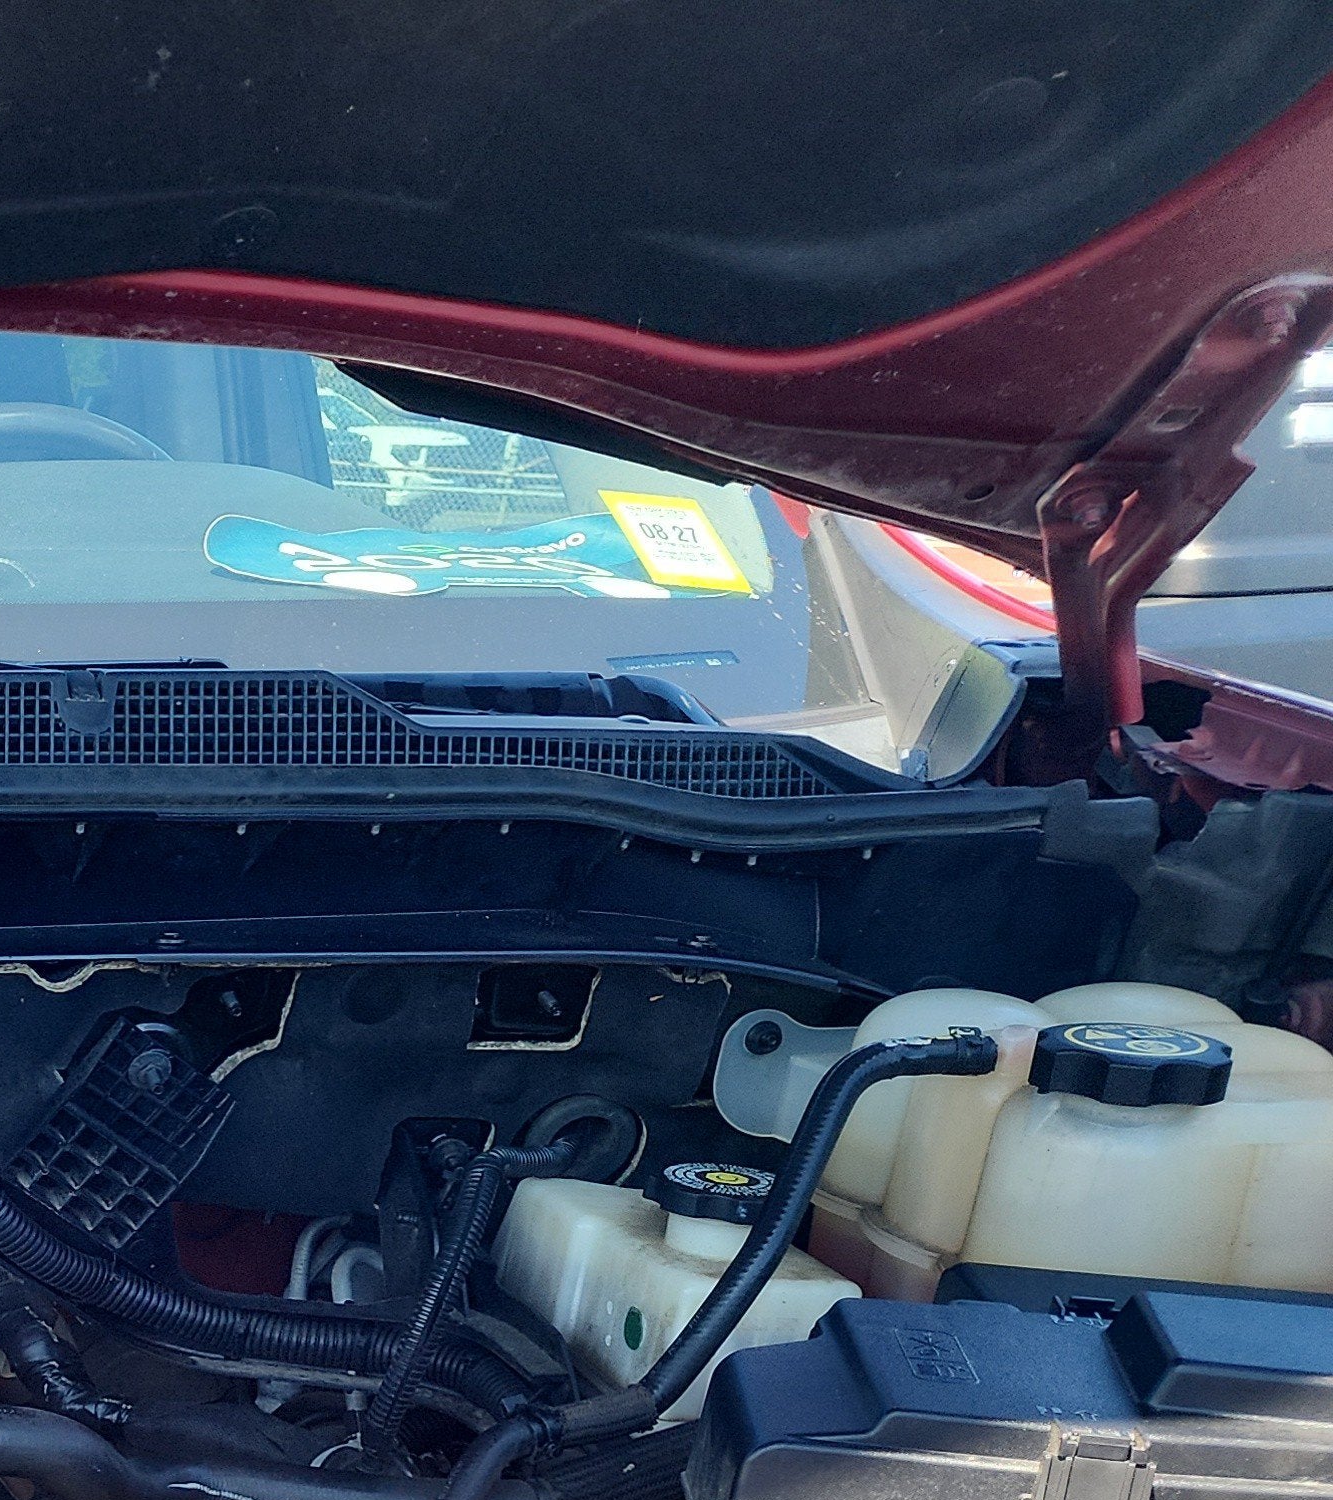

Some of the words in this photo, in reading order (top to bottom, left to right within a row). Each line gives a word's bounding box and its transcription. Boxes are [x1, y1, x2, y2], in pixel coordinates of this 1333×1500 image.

[639, 522, 668, 541] 08
[672, 525, 698, 543] 27
[279, 542, 614, 577] 2020
